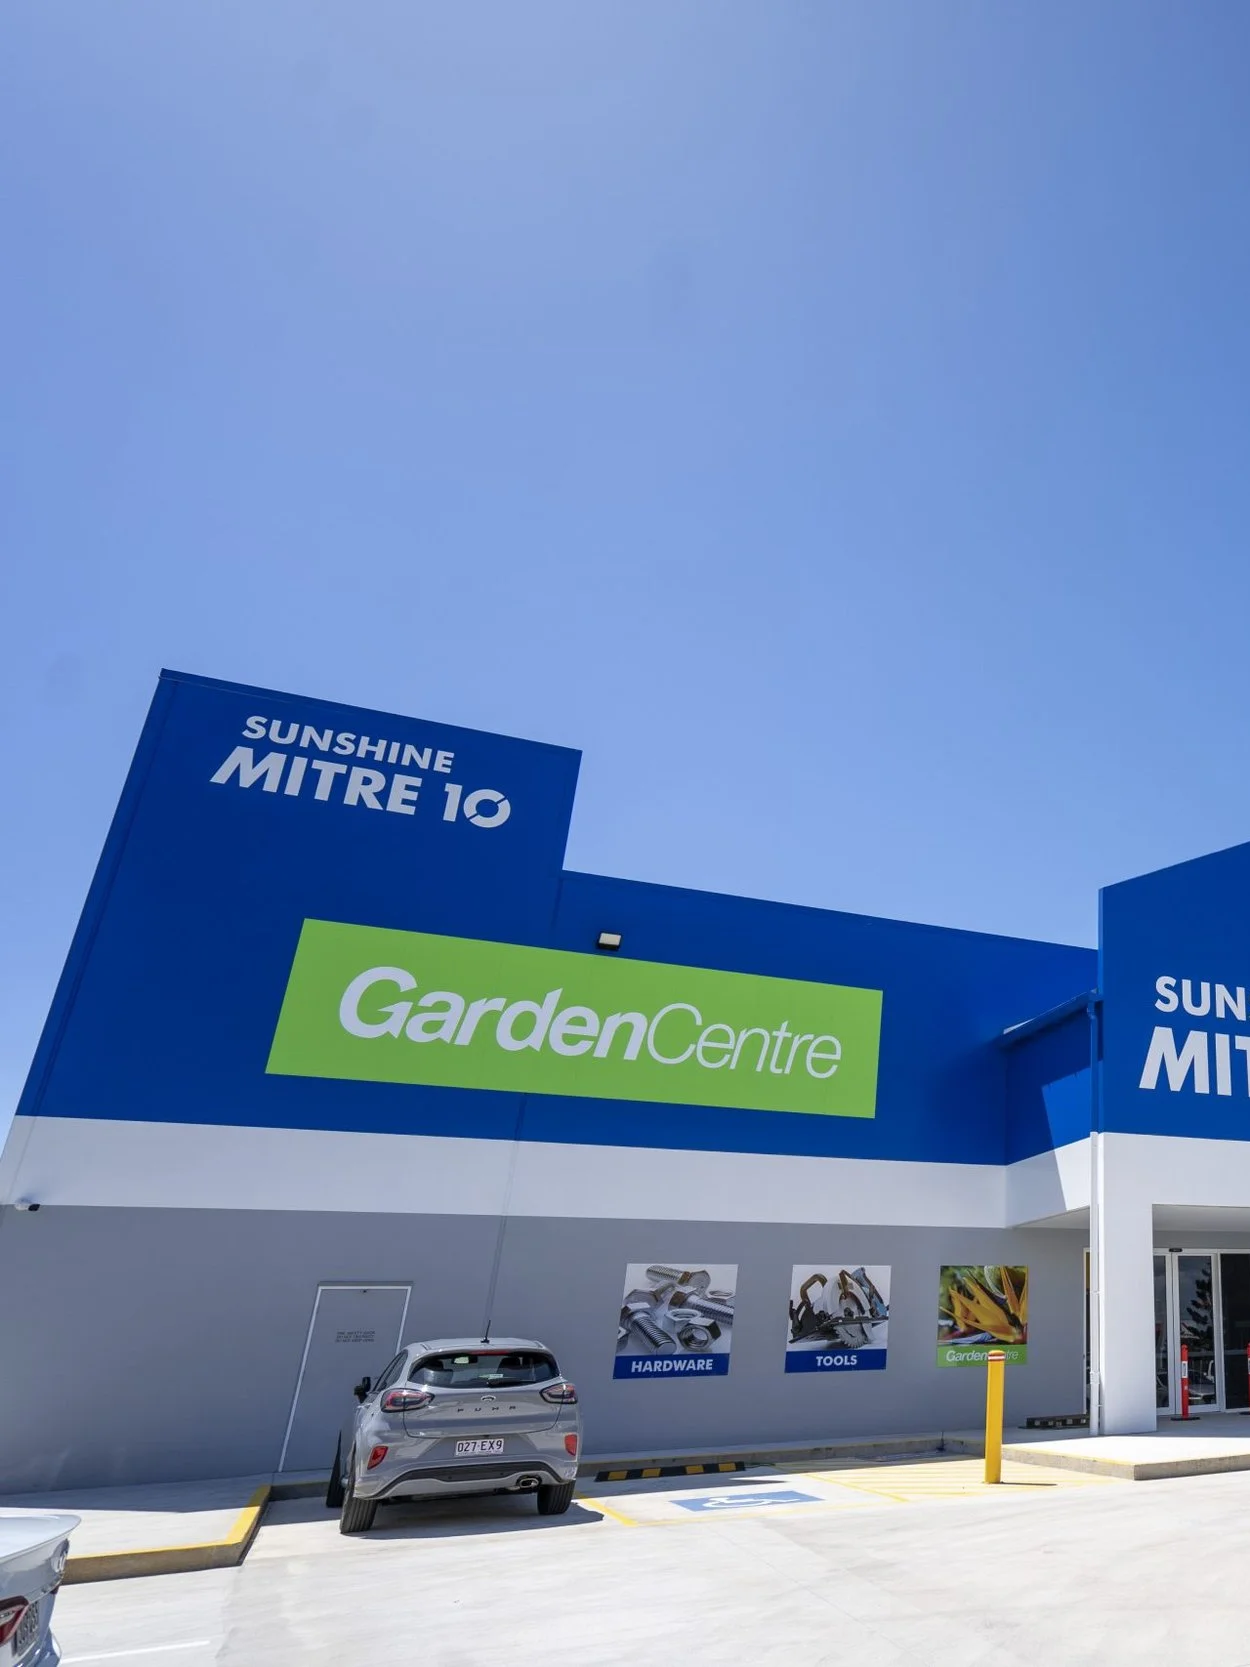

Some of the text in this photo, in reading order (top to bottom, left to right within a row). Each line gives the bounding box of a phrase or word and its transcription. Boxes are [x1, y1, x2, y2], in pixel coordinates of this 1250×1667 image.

[243, 715, 455, 774] SUNSHINE
[210, 745, 511, 828] MITRE 10
[815, 1355, 858, 1367] TOOLS
[946, 1350, 1019, 1362] Gardentre
[631, 1359, 713, 1373] HARDWARE
